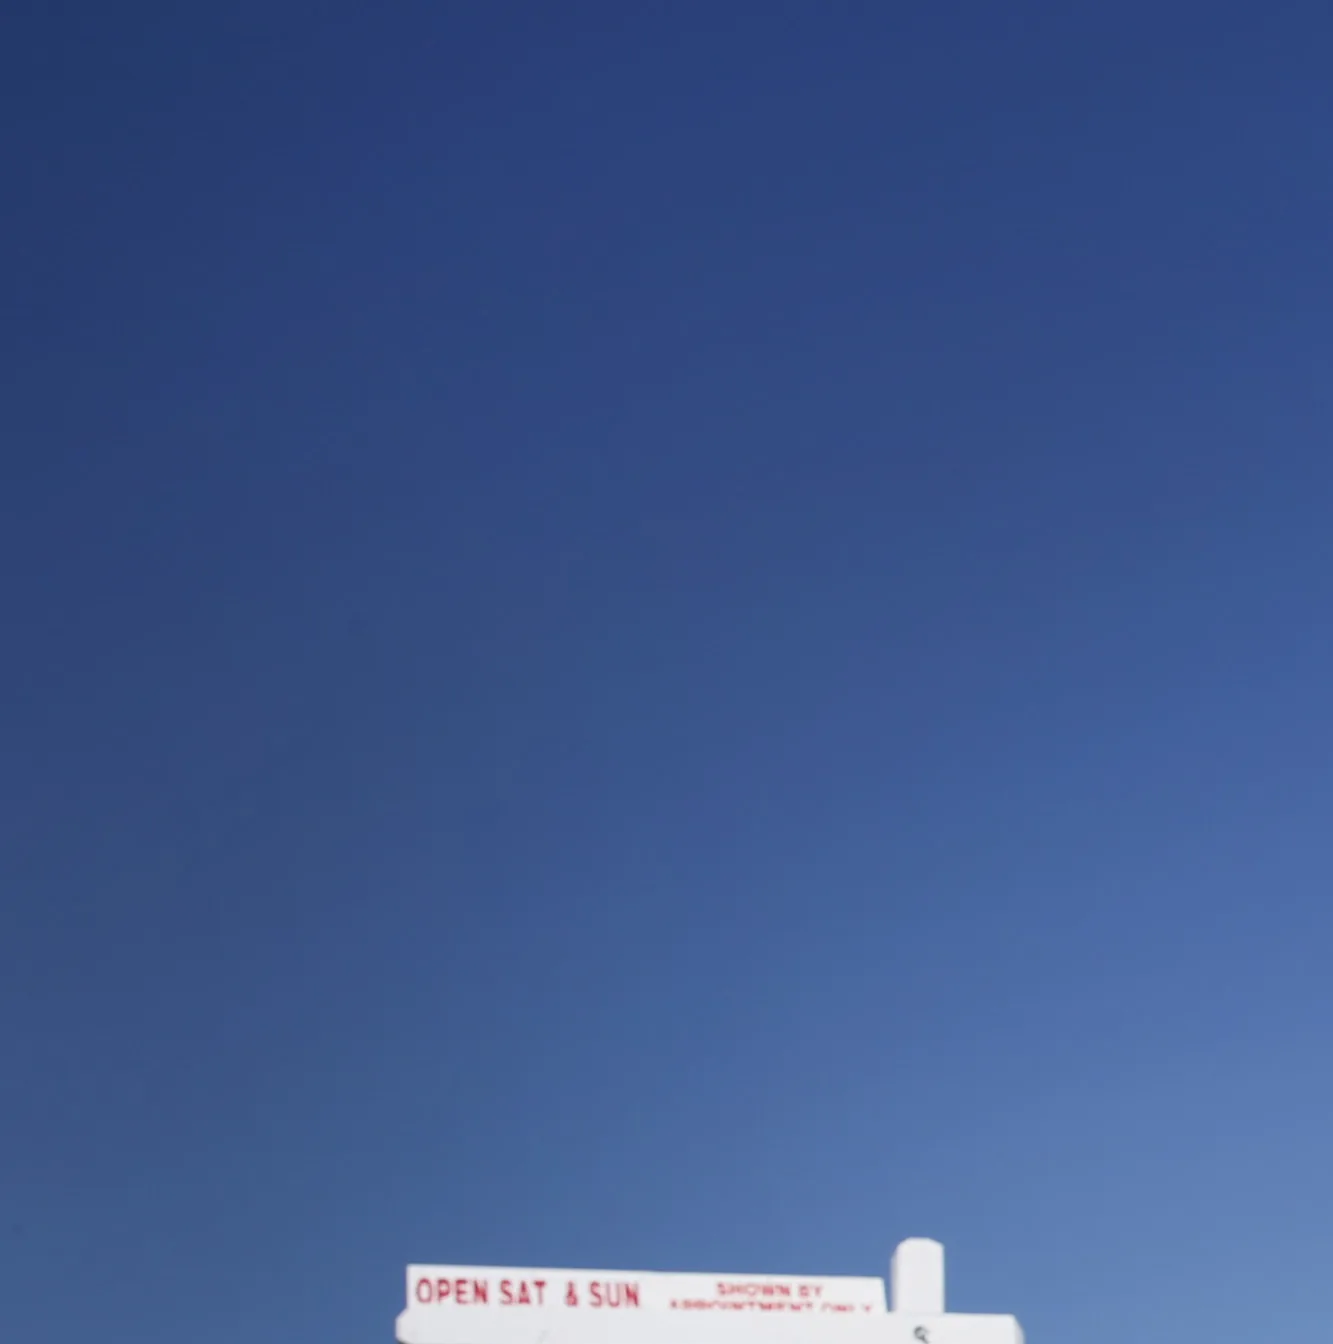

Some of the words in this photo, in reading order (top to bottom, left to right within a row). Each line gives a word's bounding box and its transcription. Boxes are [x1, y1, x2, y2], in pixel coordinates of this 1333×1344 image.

[416, 1278, 488, 1304] OPEN
[499, 1279, 546, 1305] SAT
[565, 1280, 578, 1307] &
[589, 1280, 640, 1308] SUN
[717, 1283, 791, 1296] SHOWN
